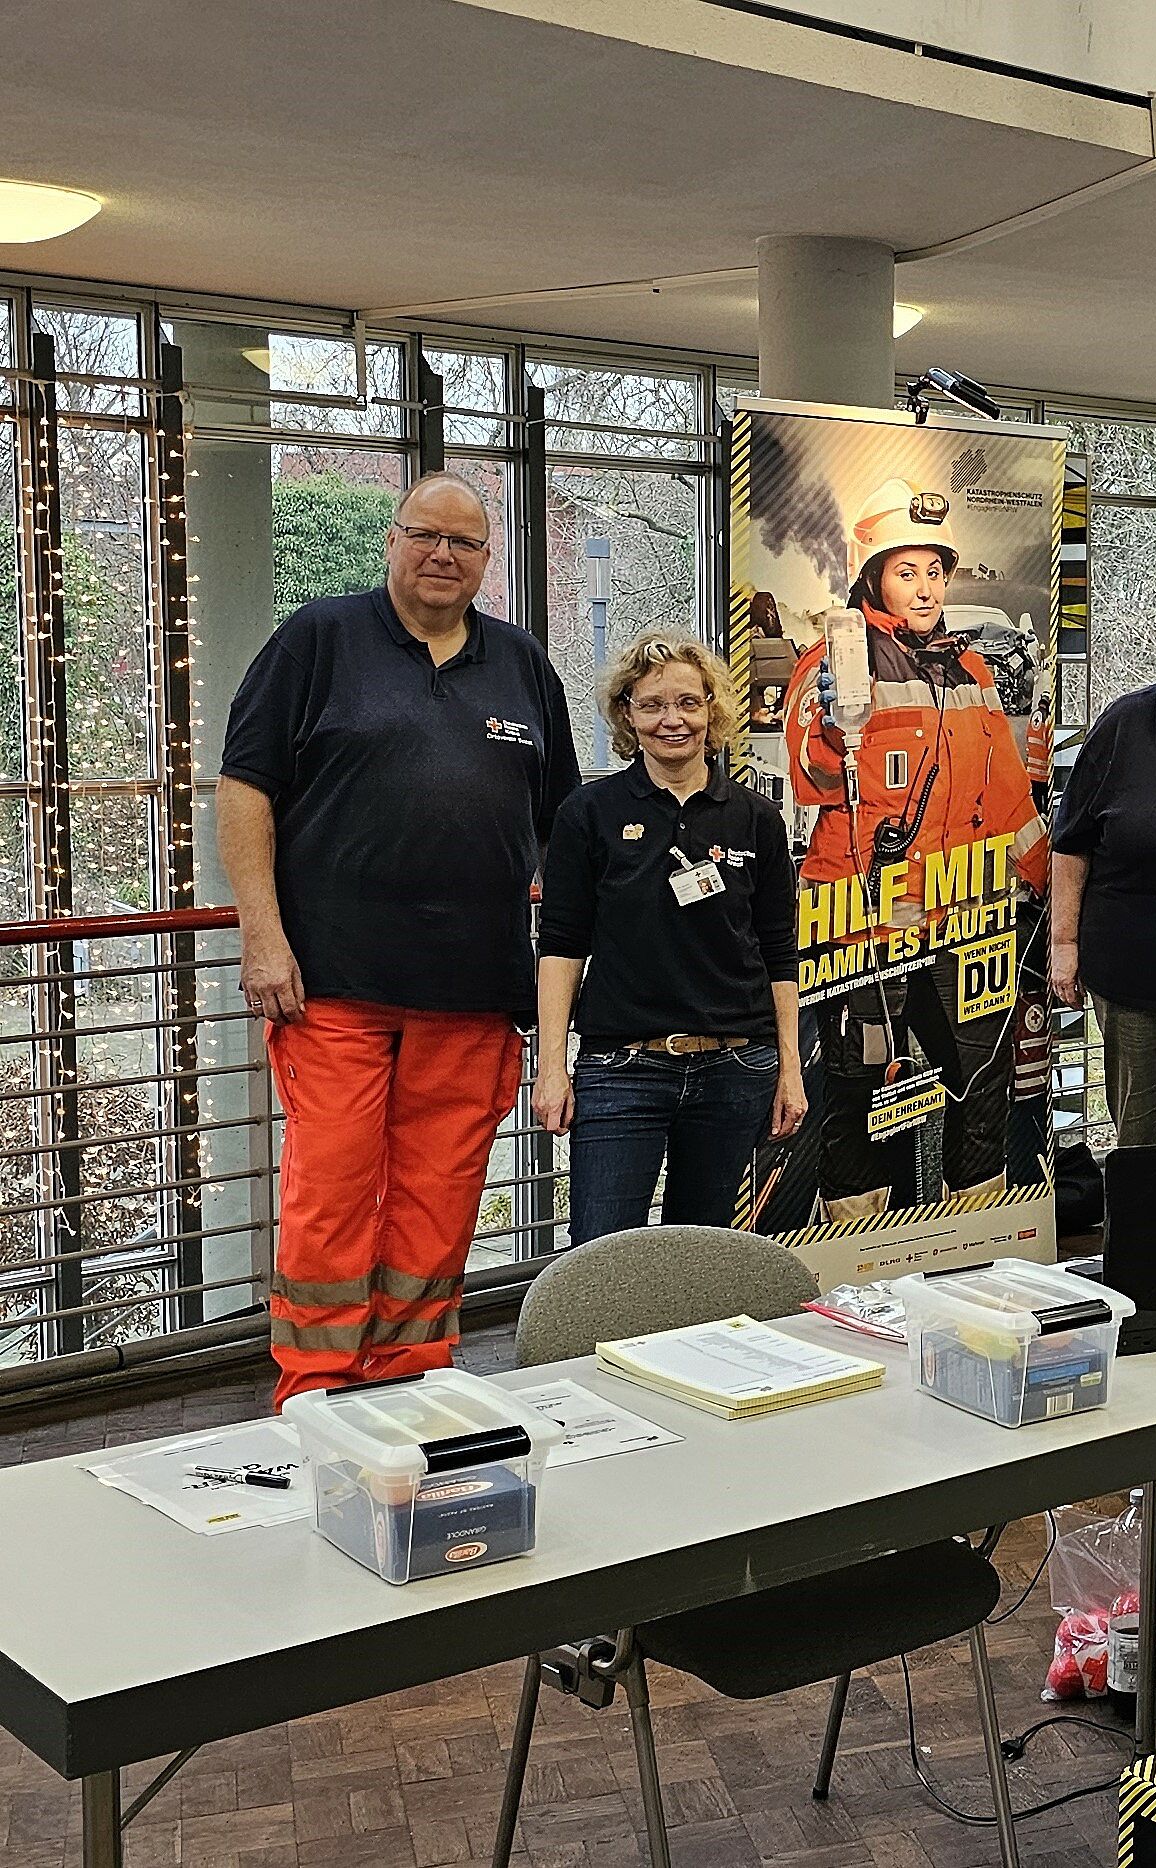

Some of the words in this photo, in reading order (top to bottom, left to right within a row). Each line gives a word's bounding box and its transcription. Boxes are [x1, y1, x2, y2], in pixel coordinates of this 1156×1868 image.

[798, 860, 909, 950] HILF
[925, 832, 1017, 912] MIT,
[798, 937, 881, 993] DAMIT
[888, 925, 920, 963] ES
[929, 897, 1017, 950] LÄUFT!
[964, 946, 987, 960] WENN
[989, 939, 1011, 954] NICHT
[964, 952, 1011, 1002] DU,
[964, 1003, 981, 1015] WER
[871, 1110, 893, 1126] DEIN
[895, 1091, 944, 1118] EHRENAMT
